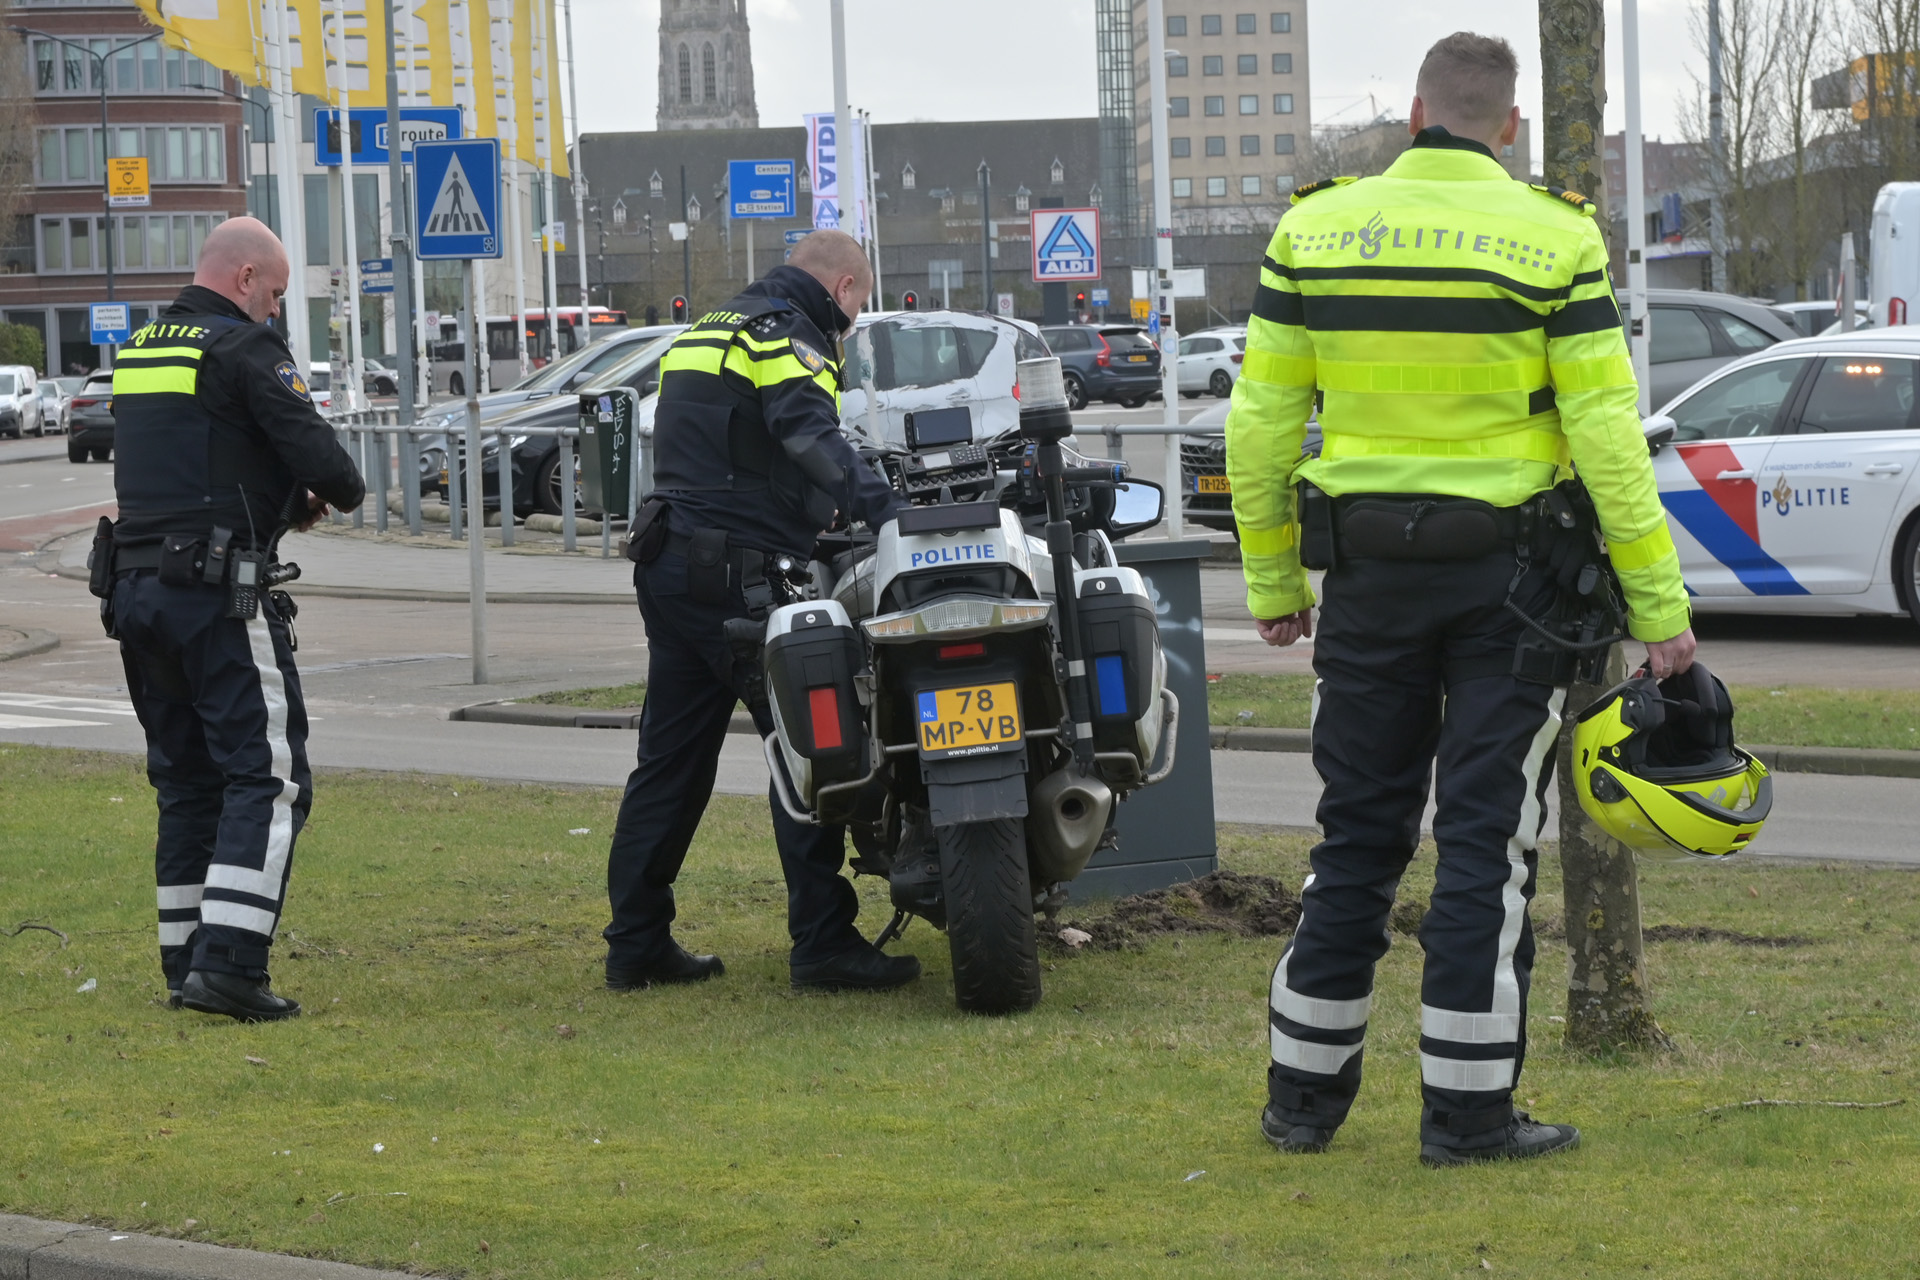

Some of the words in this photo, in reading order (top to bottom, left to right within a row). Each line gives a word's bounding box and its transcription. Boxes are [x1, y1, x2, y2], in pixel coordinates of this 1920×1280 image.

[401, 128, 444, 142] route
[1339, 227, 1491, 260] POLITIE
[1044, 260, 1090, 274] ALDI
[1762, 487, 1849, 516] POLITIE
[911, 544, 995, 567] POLITIE
[956, 689, 994, 715] 78
[924, 715, 1016, 747] MP-VB
[947, 744, 999, 756] www.politie.nl
